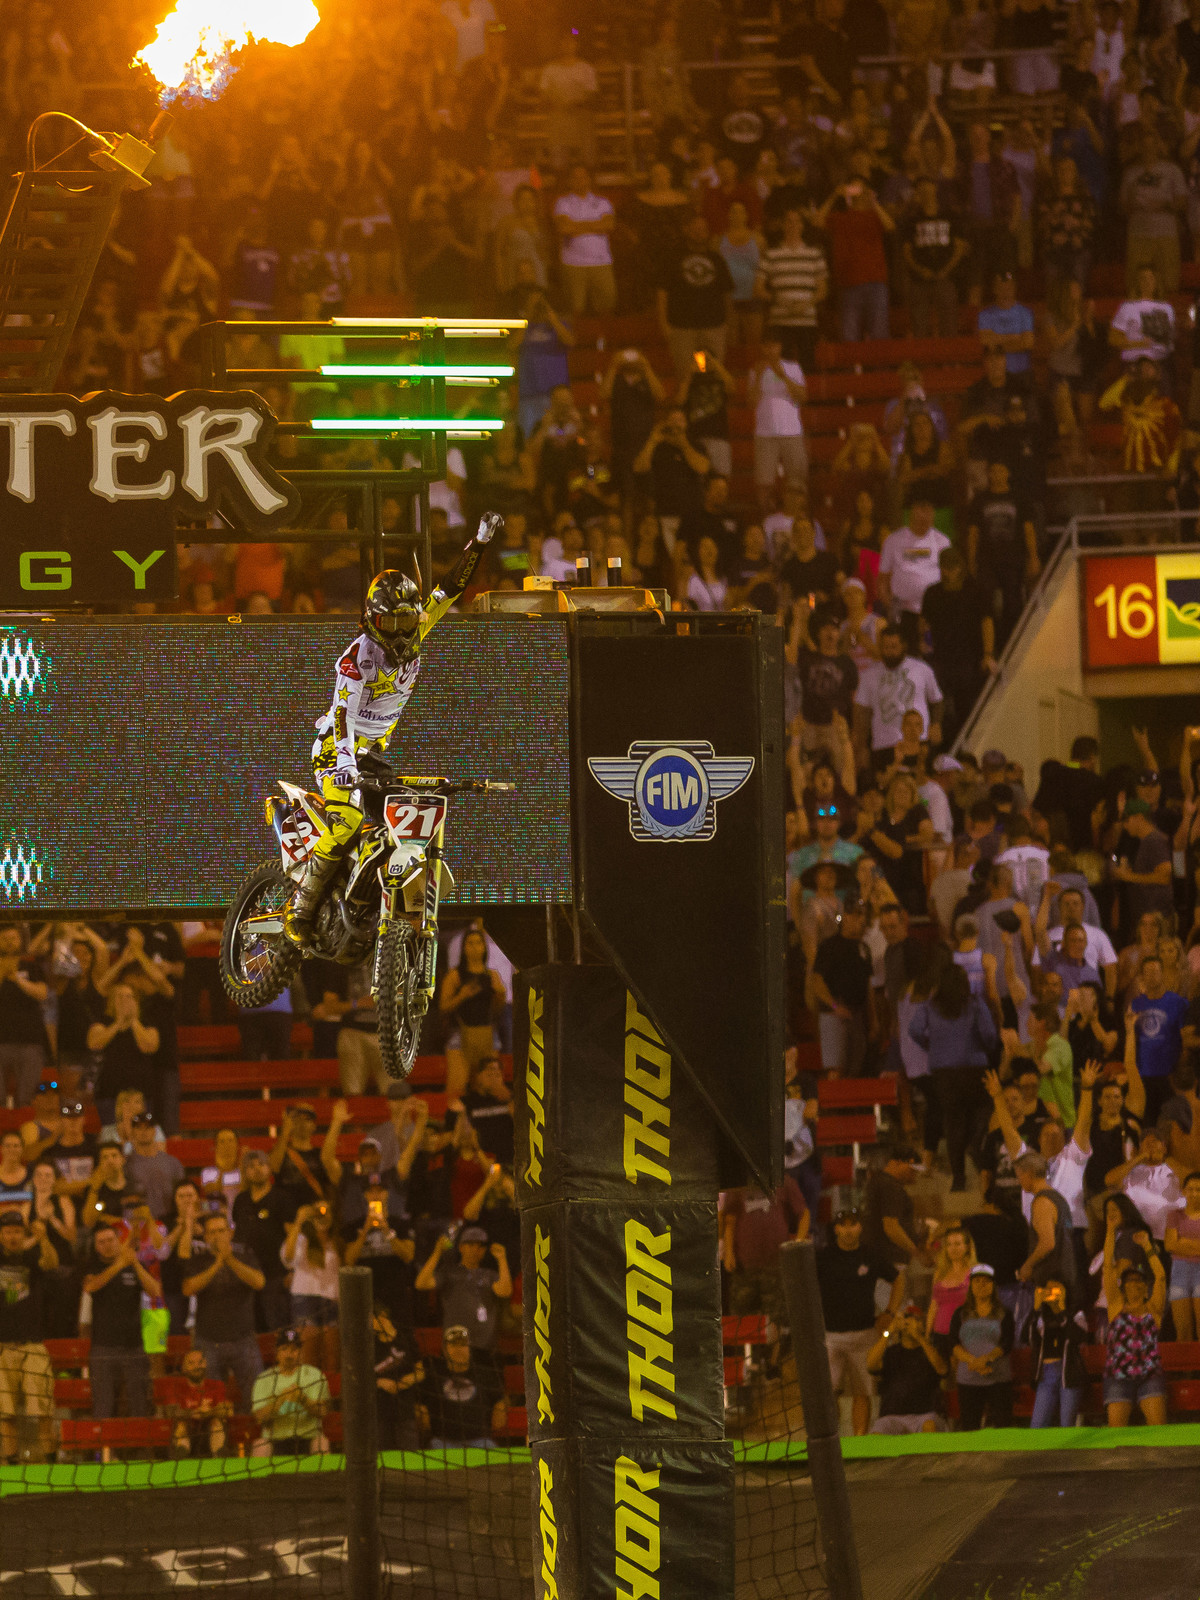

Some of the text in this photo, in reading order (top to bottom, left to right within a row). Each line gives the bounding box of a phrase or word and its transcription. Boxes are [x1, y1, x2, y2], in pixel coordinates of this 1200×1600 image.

[1093, 582, 1156, 640] 16
[647, 772, 699, 811] FIM
[393, 805, 438, 838] 21
[424, 940, 433, 984] DUNLOP
[624, 1218, 678, 1423] THOR
